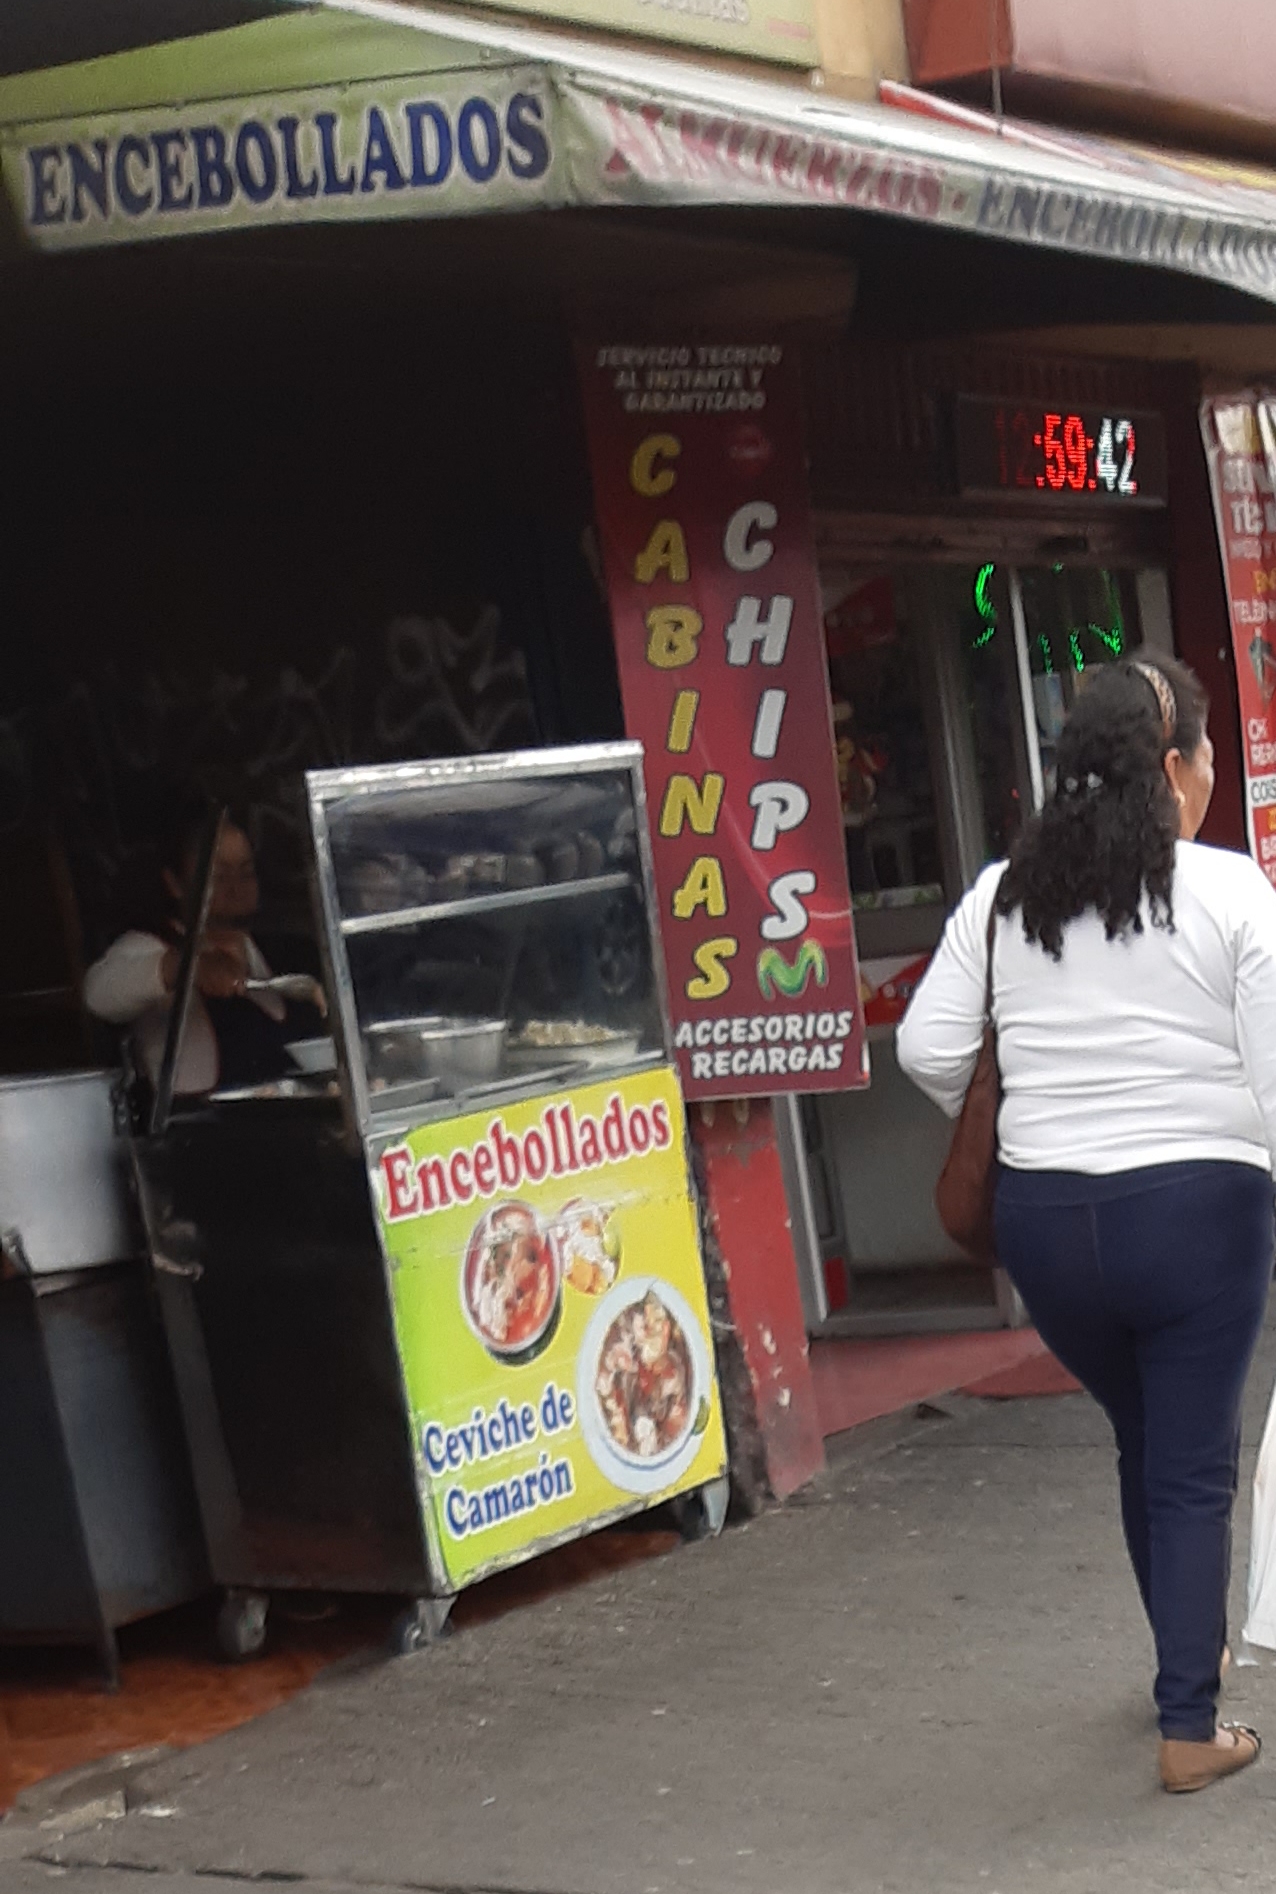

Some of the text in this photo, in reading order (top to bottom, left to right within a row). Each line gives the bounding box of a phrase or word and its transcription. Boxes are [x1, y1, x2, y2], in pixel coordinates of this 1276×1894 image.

[26, 92, 555, 226] ENCEBOLLADOS
[674, 1010, 854, 1050] ACCESORIOS
[691, 1043, 845, 1080] RECARGAS
[381, 1097, 671, 1217] Encebollados
[423, 1382, 574, 1474] Ceviche de
[445, 1455, 574, 1535] Camarón
